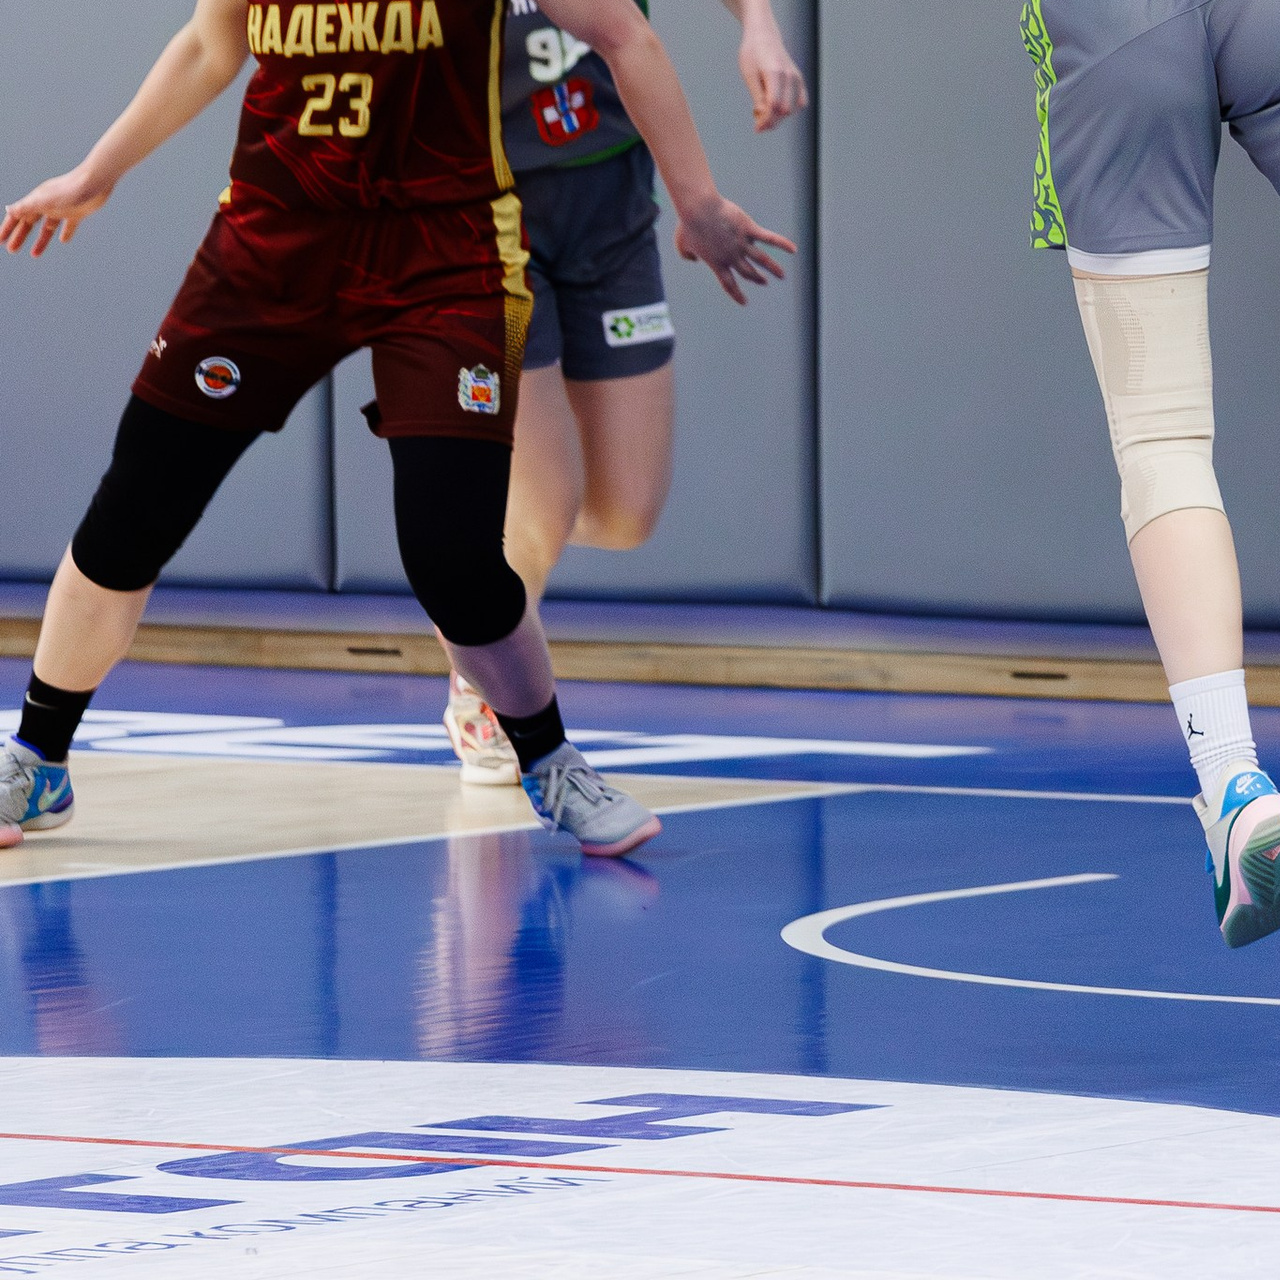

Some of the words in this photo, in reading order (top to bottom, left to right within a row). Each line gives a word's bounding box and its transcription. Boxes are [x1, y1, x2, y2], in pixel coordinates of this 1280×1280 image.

[247, 0, 445, 59] НАДЕЖДА
[297, 71, 374, 139] 23
[162, 1175, 614, 1241] компаний
